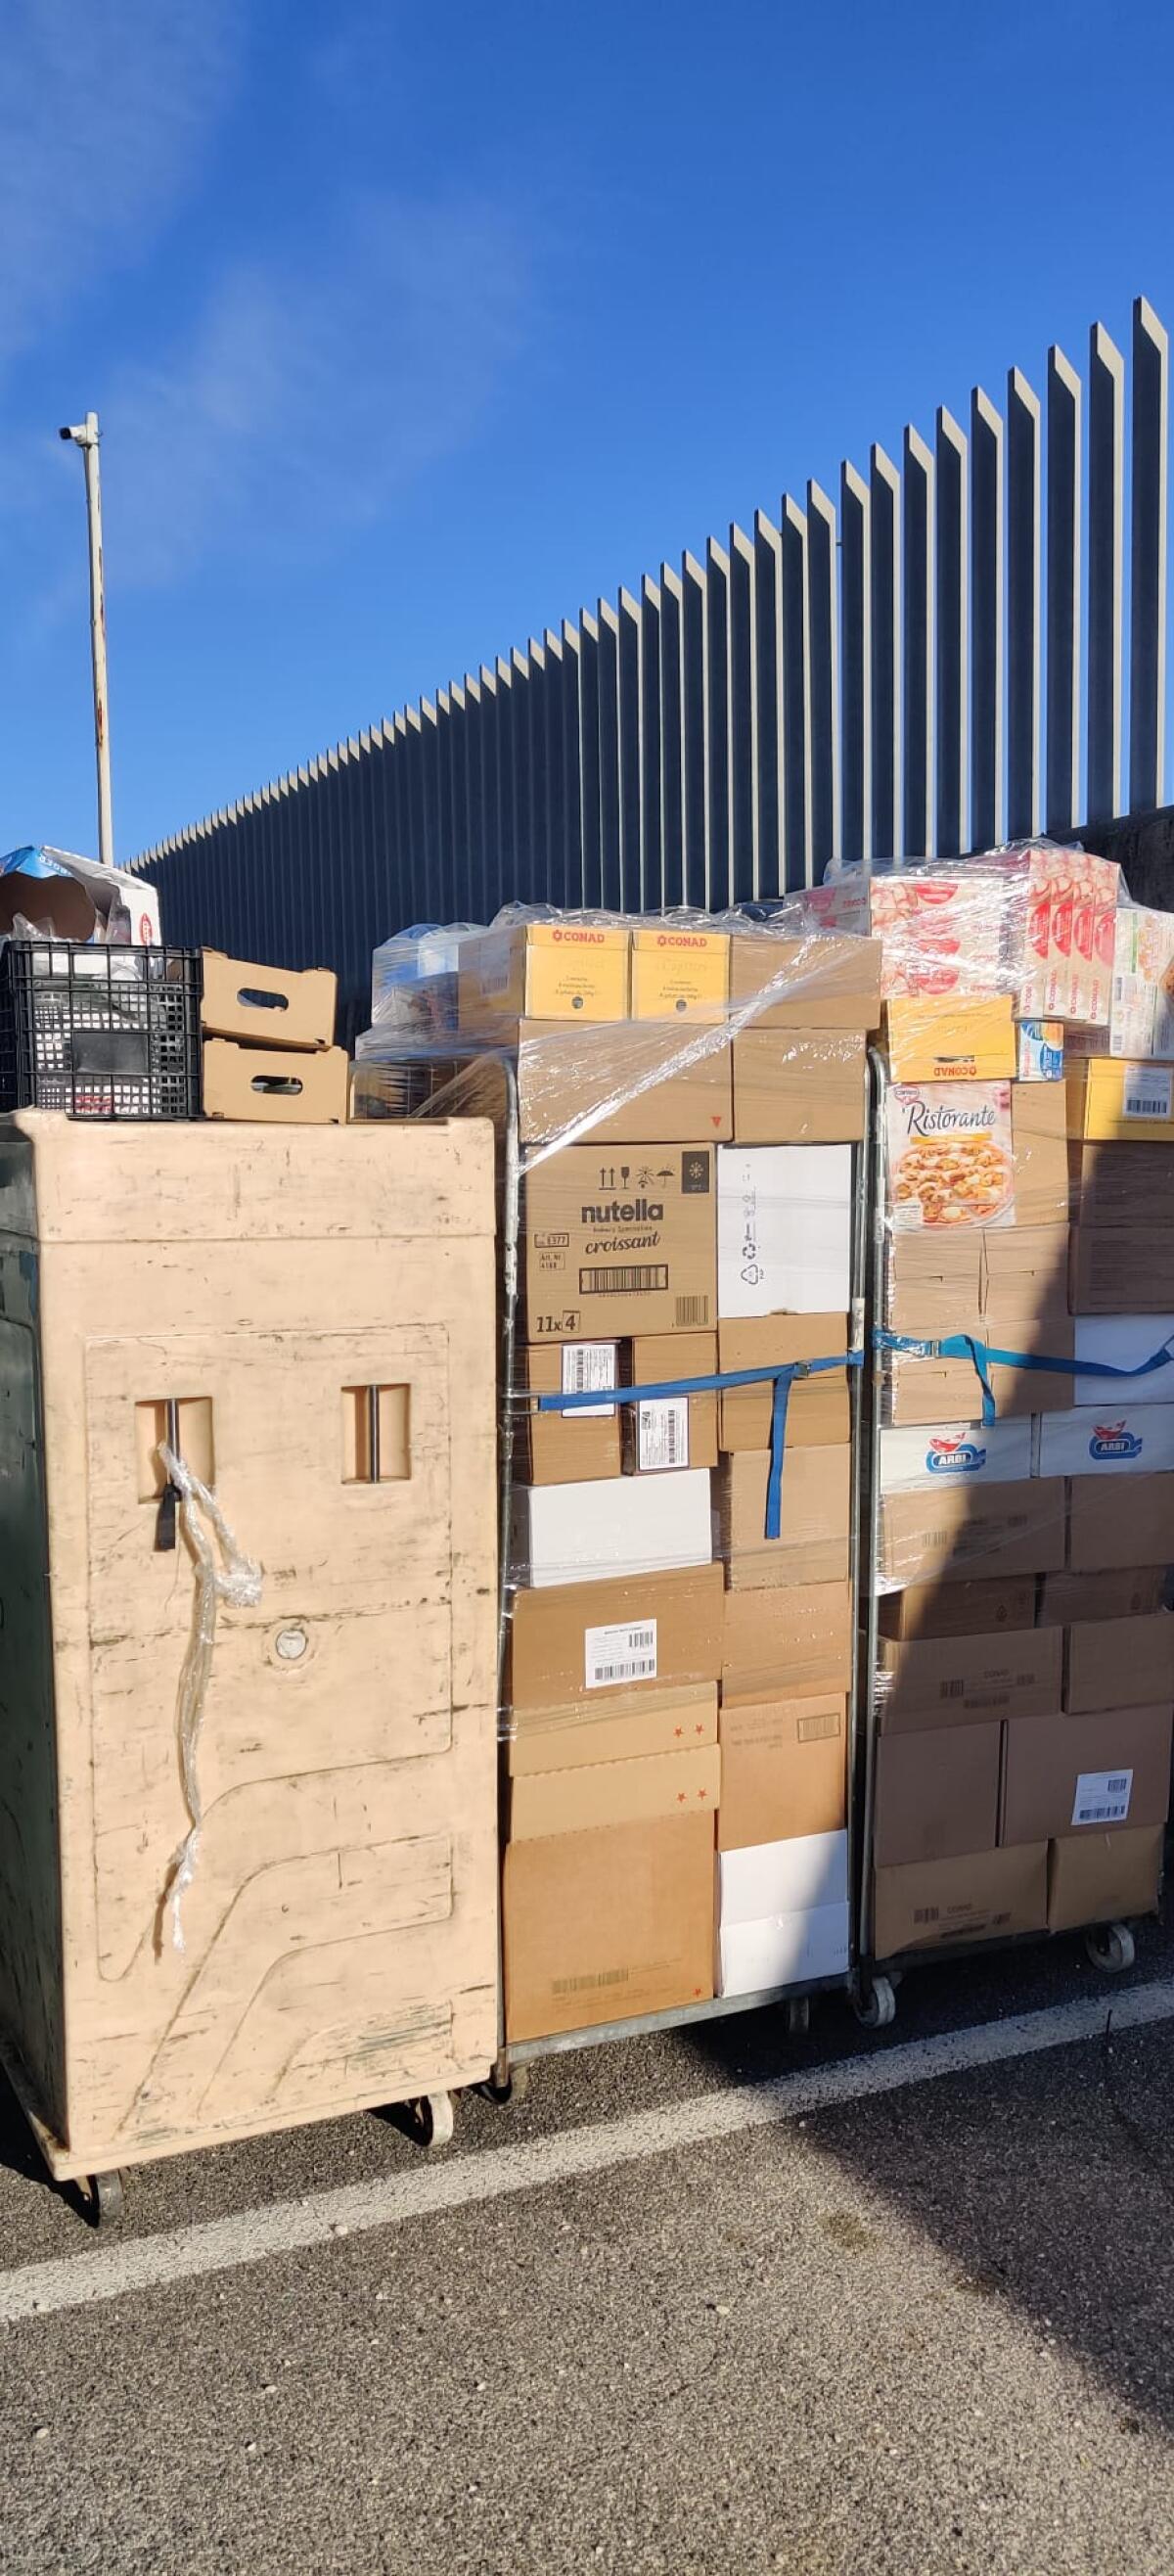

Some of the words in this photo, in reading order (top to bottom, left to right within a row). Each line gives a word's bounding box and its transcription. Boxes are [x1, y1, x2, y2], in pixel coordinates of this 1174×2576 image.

[564, 931, 605, 943] CONAD
[667, 937, 707, 947] CONAD
[933, 1067, 968, 1077] CONAD
[907, 1100, 996, 1136] Ristorante
[581, 1198, 663, 1223] nutella
[585, 1230, 661, 1254] croissant
[938, 1453, 967, 1465] ARBI
